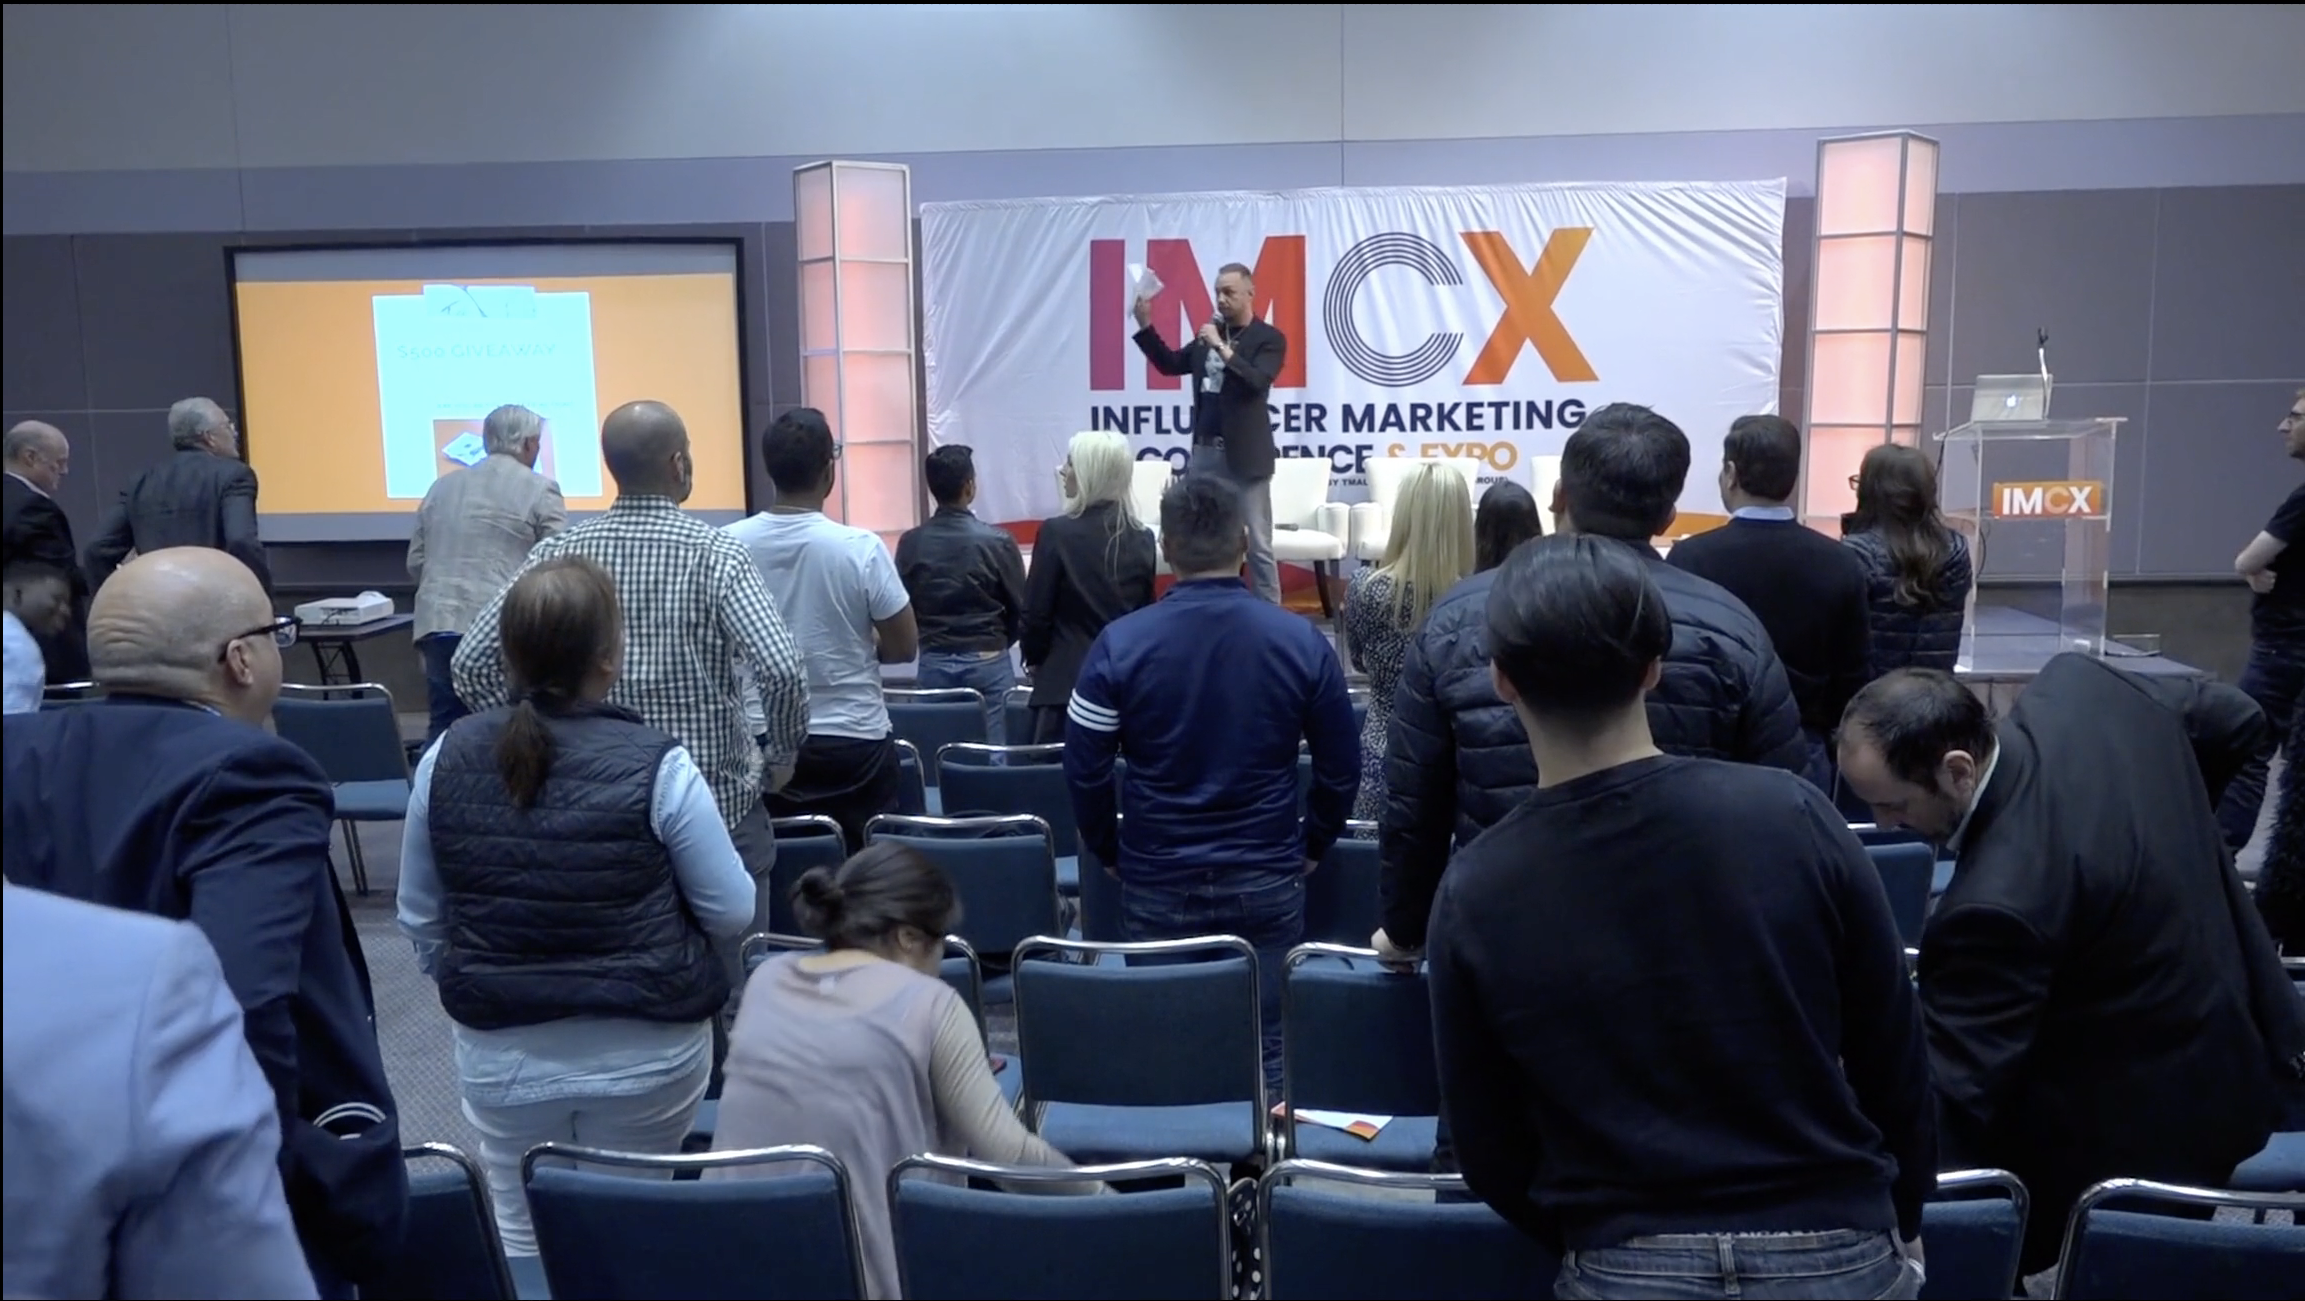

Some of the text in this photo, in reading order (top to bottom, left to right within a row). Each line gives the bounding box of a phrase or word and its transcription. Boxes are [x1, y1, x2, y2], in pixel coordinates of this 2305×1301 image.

[1090, 227, 1599, 388] IMCX
[451, 343, 556, 358] GIVEAWAY
[1091, 399, 1587, 434] INFLUER MARKETING
[1136, 444, 1373, 476] CONCE
[1420, 441, 1518, 471] EXPO
[2002, 486, 2093, 515] IMCX
